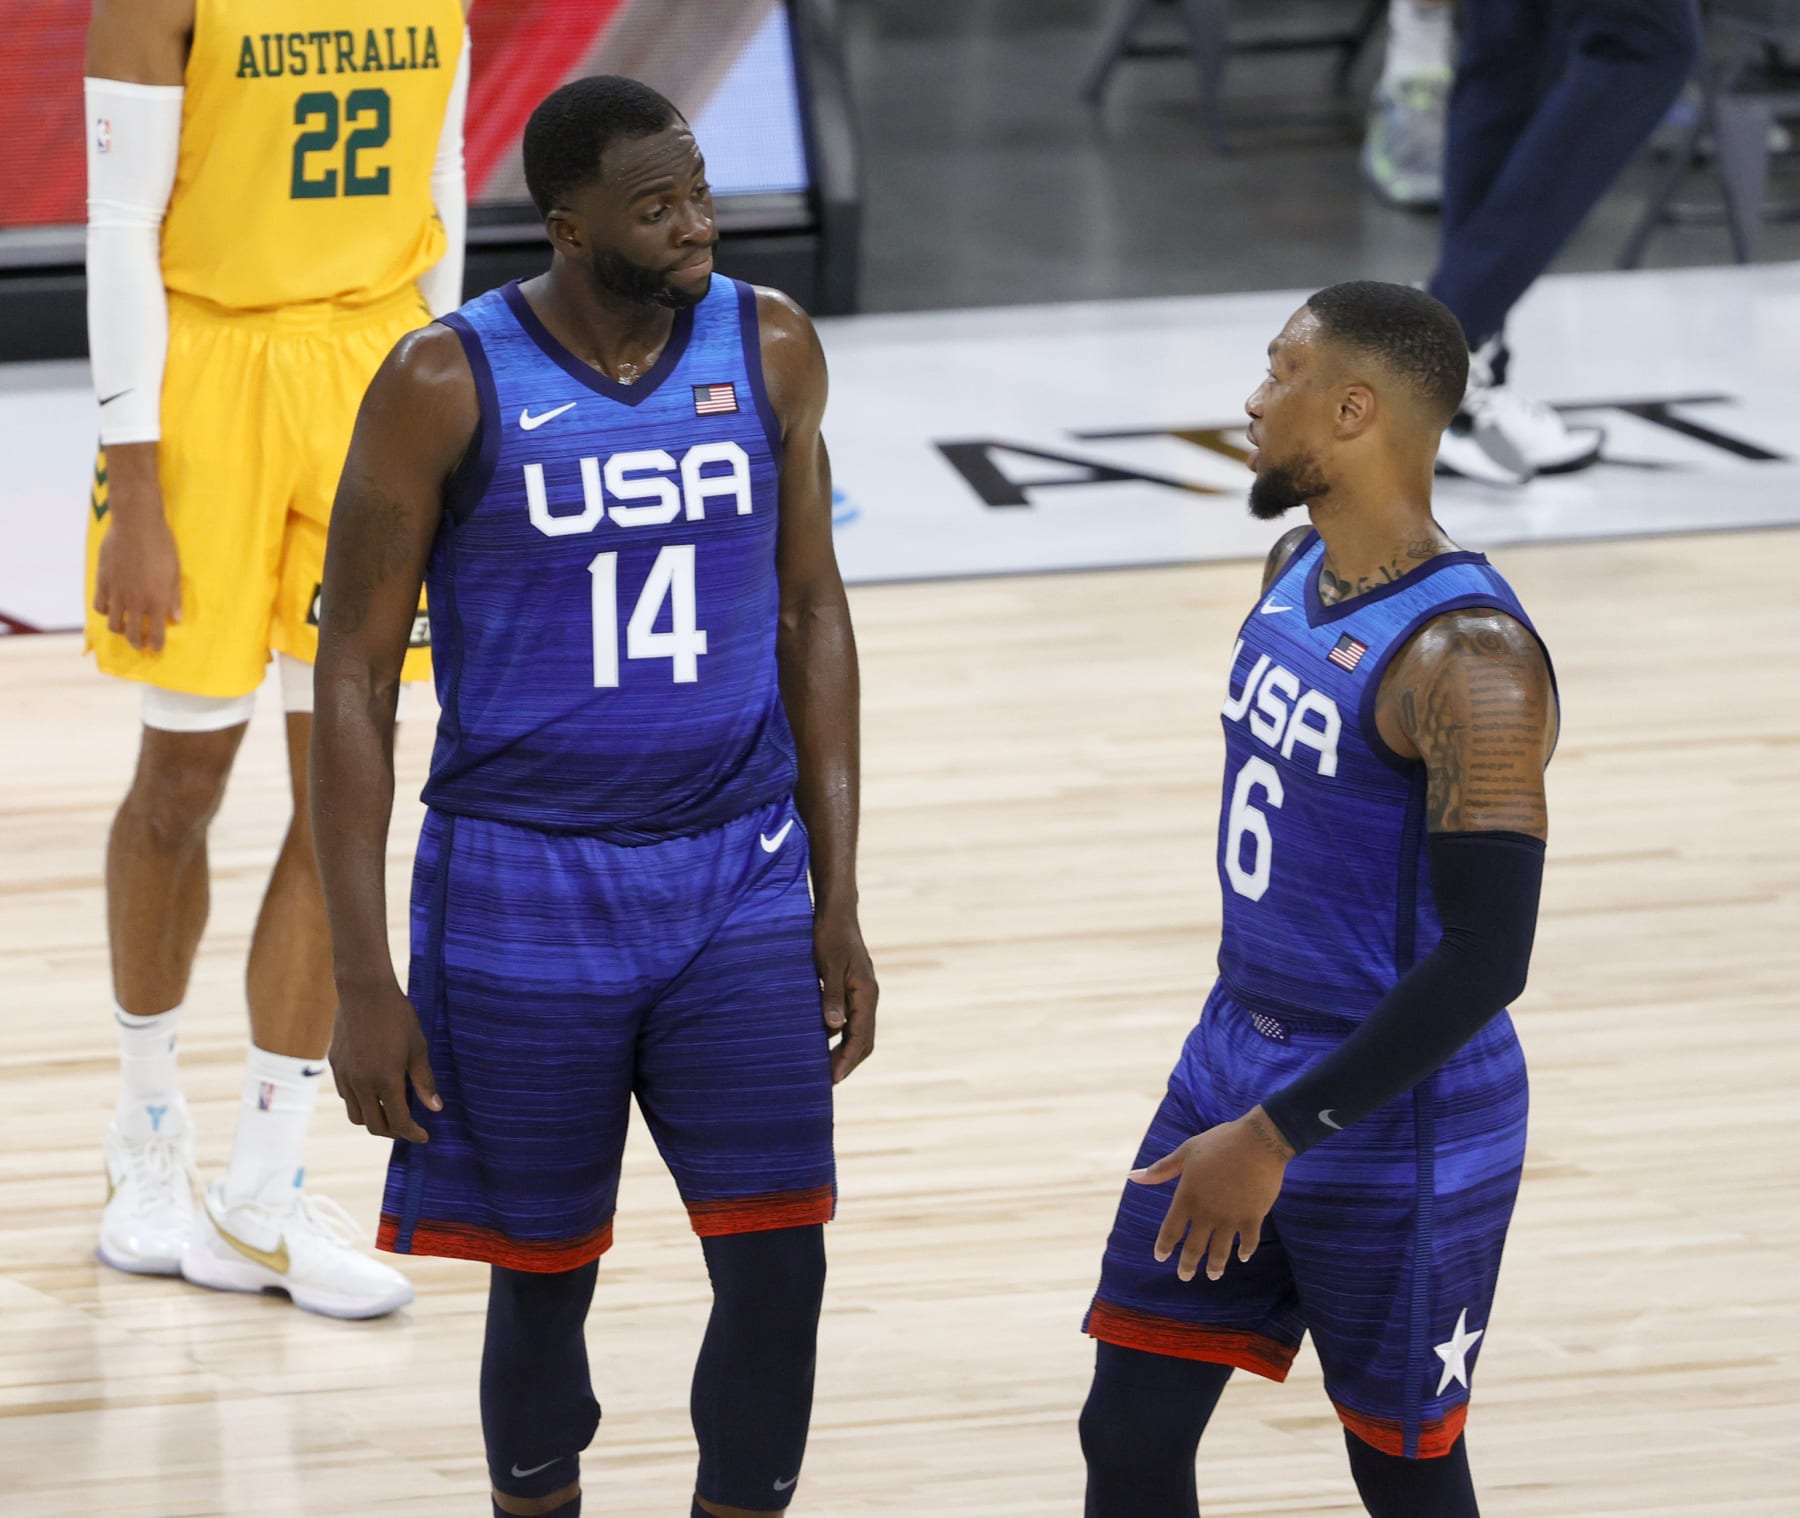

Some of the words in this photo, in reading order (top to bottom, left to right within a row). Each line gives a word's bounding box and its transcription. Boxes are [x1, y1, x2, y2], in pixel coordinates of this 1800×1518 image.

[236, 25, 440, 78] AUSTRALIA
[289, 87, 391, 199] 22
[523, 441, 752, 537] USA
[931, 394, 1790, 507] ATT
[587, 544, 707, 688] 14
[1221, 638, 1342, 777] USA
[1225, 755, 1284, 902] 6
